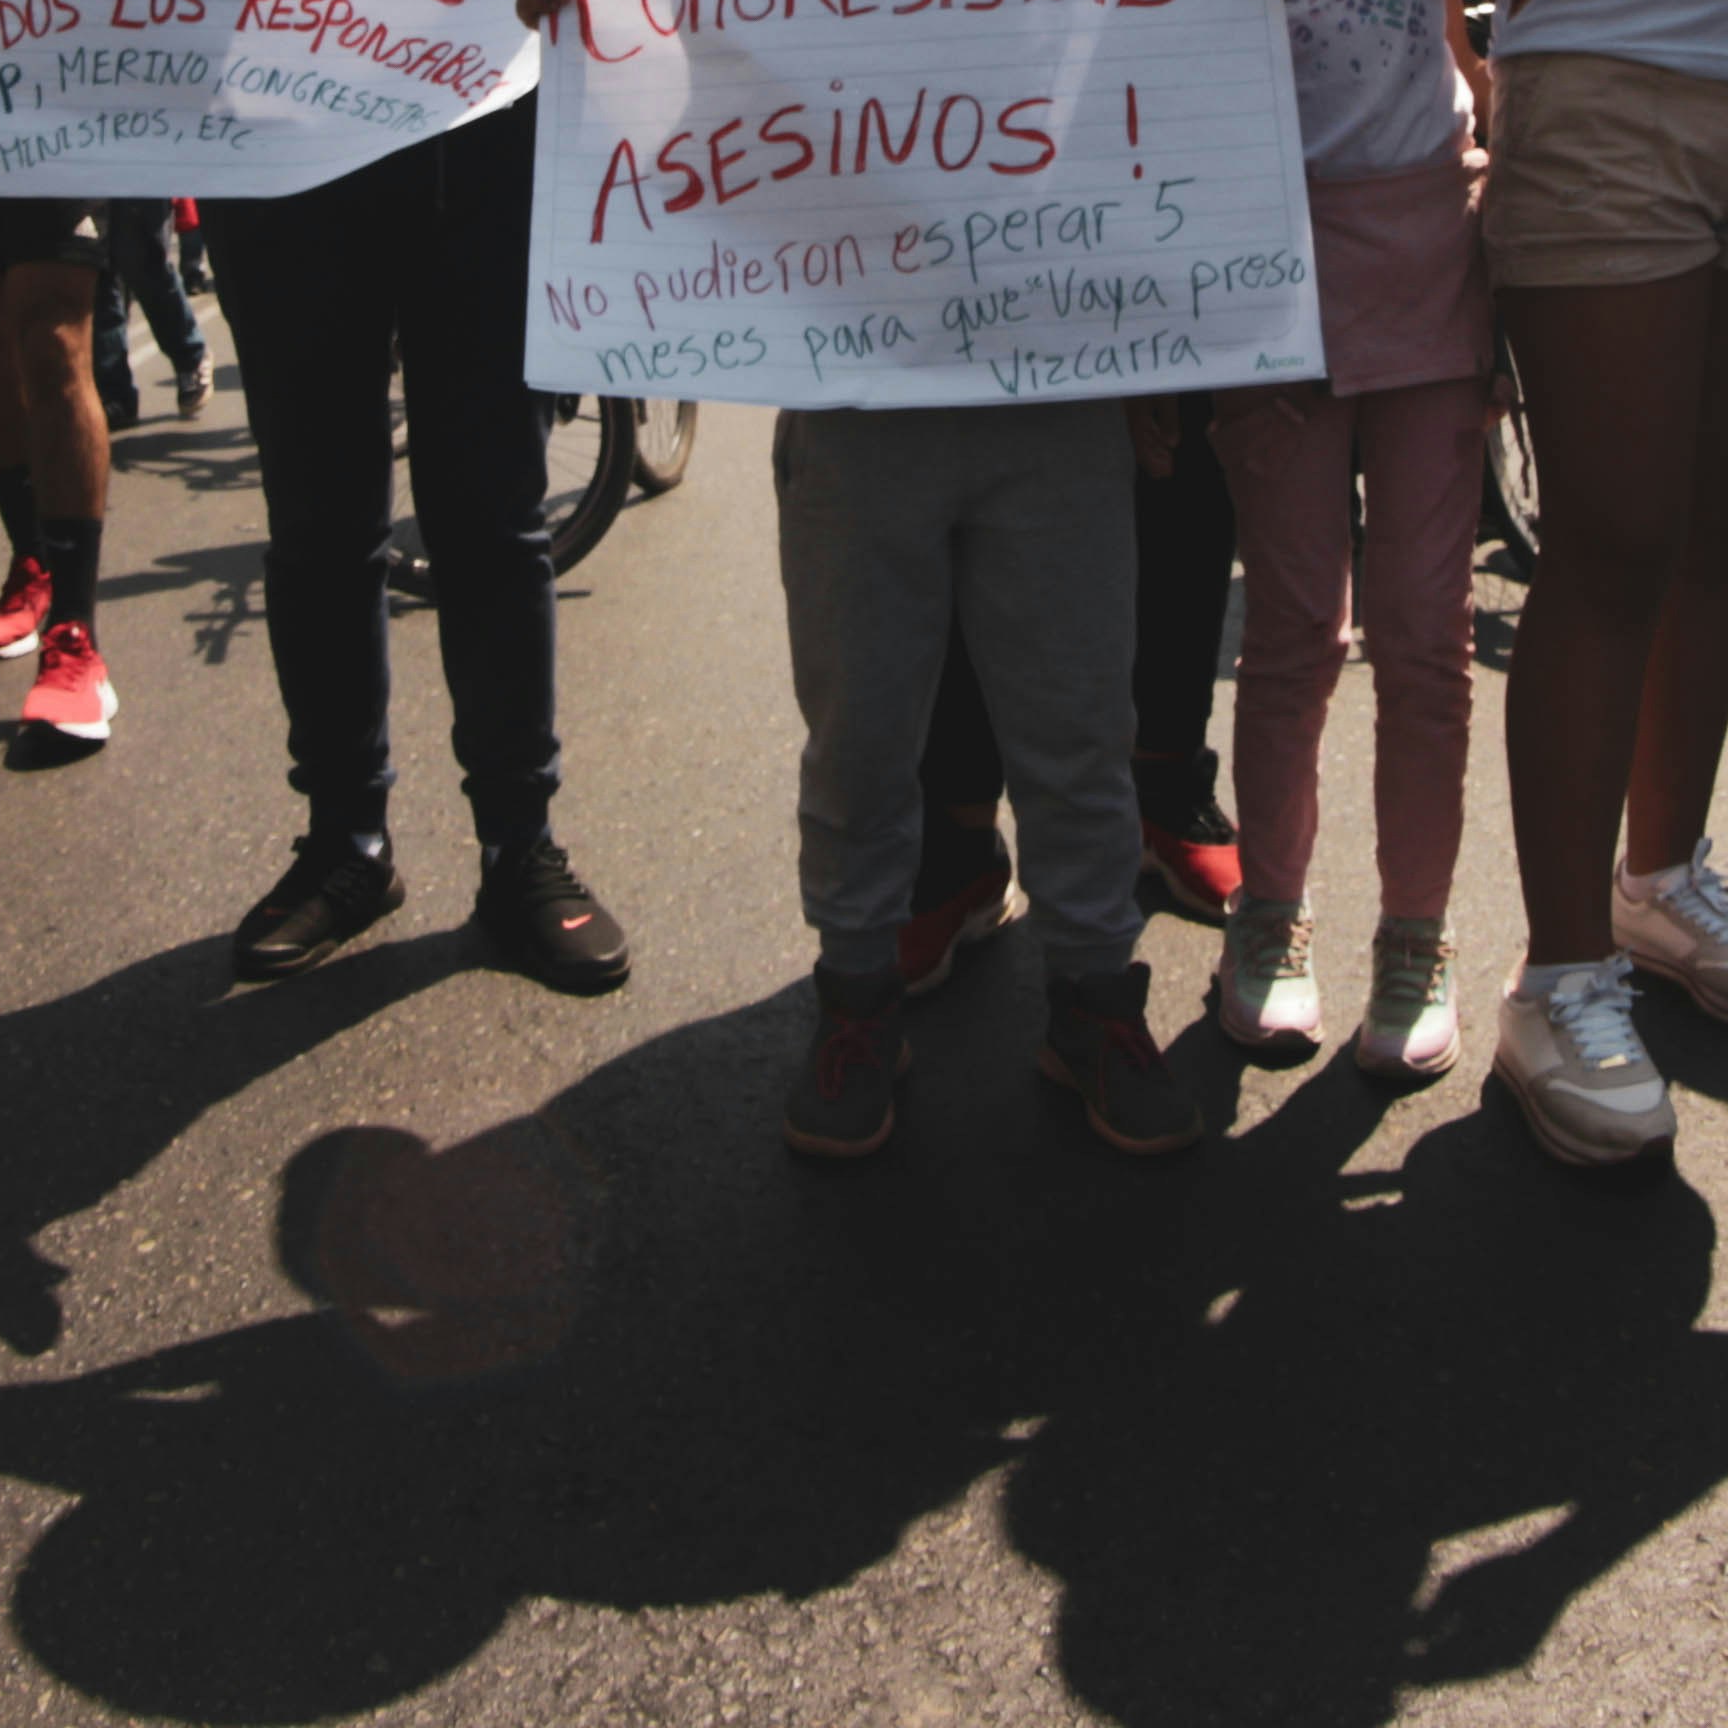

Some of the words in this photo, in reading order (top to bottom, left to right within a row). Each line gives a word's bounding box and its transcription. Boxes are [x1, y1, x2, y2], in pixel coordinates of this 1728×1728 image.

[597, 326, 766, 384] meses
[803, 313, 915, 381] para
[941, 287, 1030, 363] que
[1190, 248, 1306, 320] preso
[634, 238, 865, 332] pudieron
[891, 197, 1121, 282] esperar
[1154, 177, 1196, 242] 5
[989, 329, 1202, 395] Vizcarra
